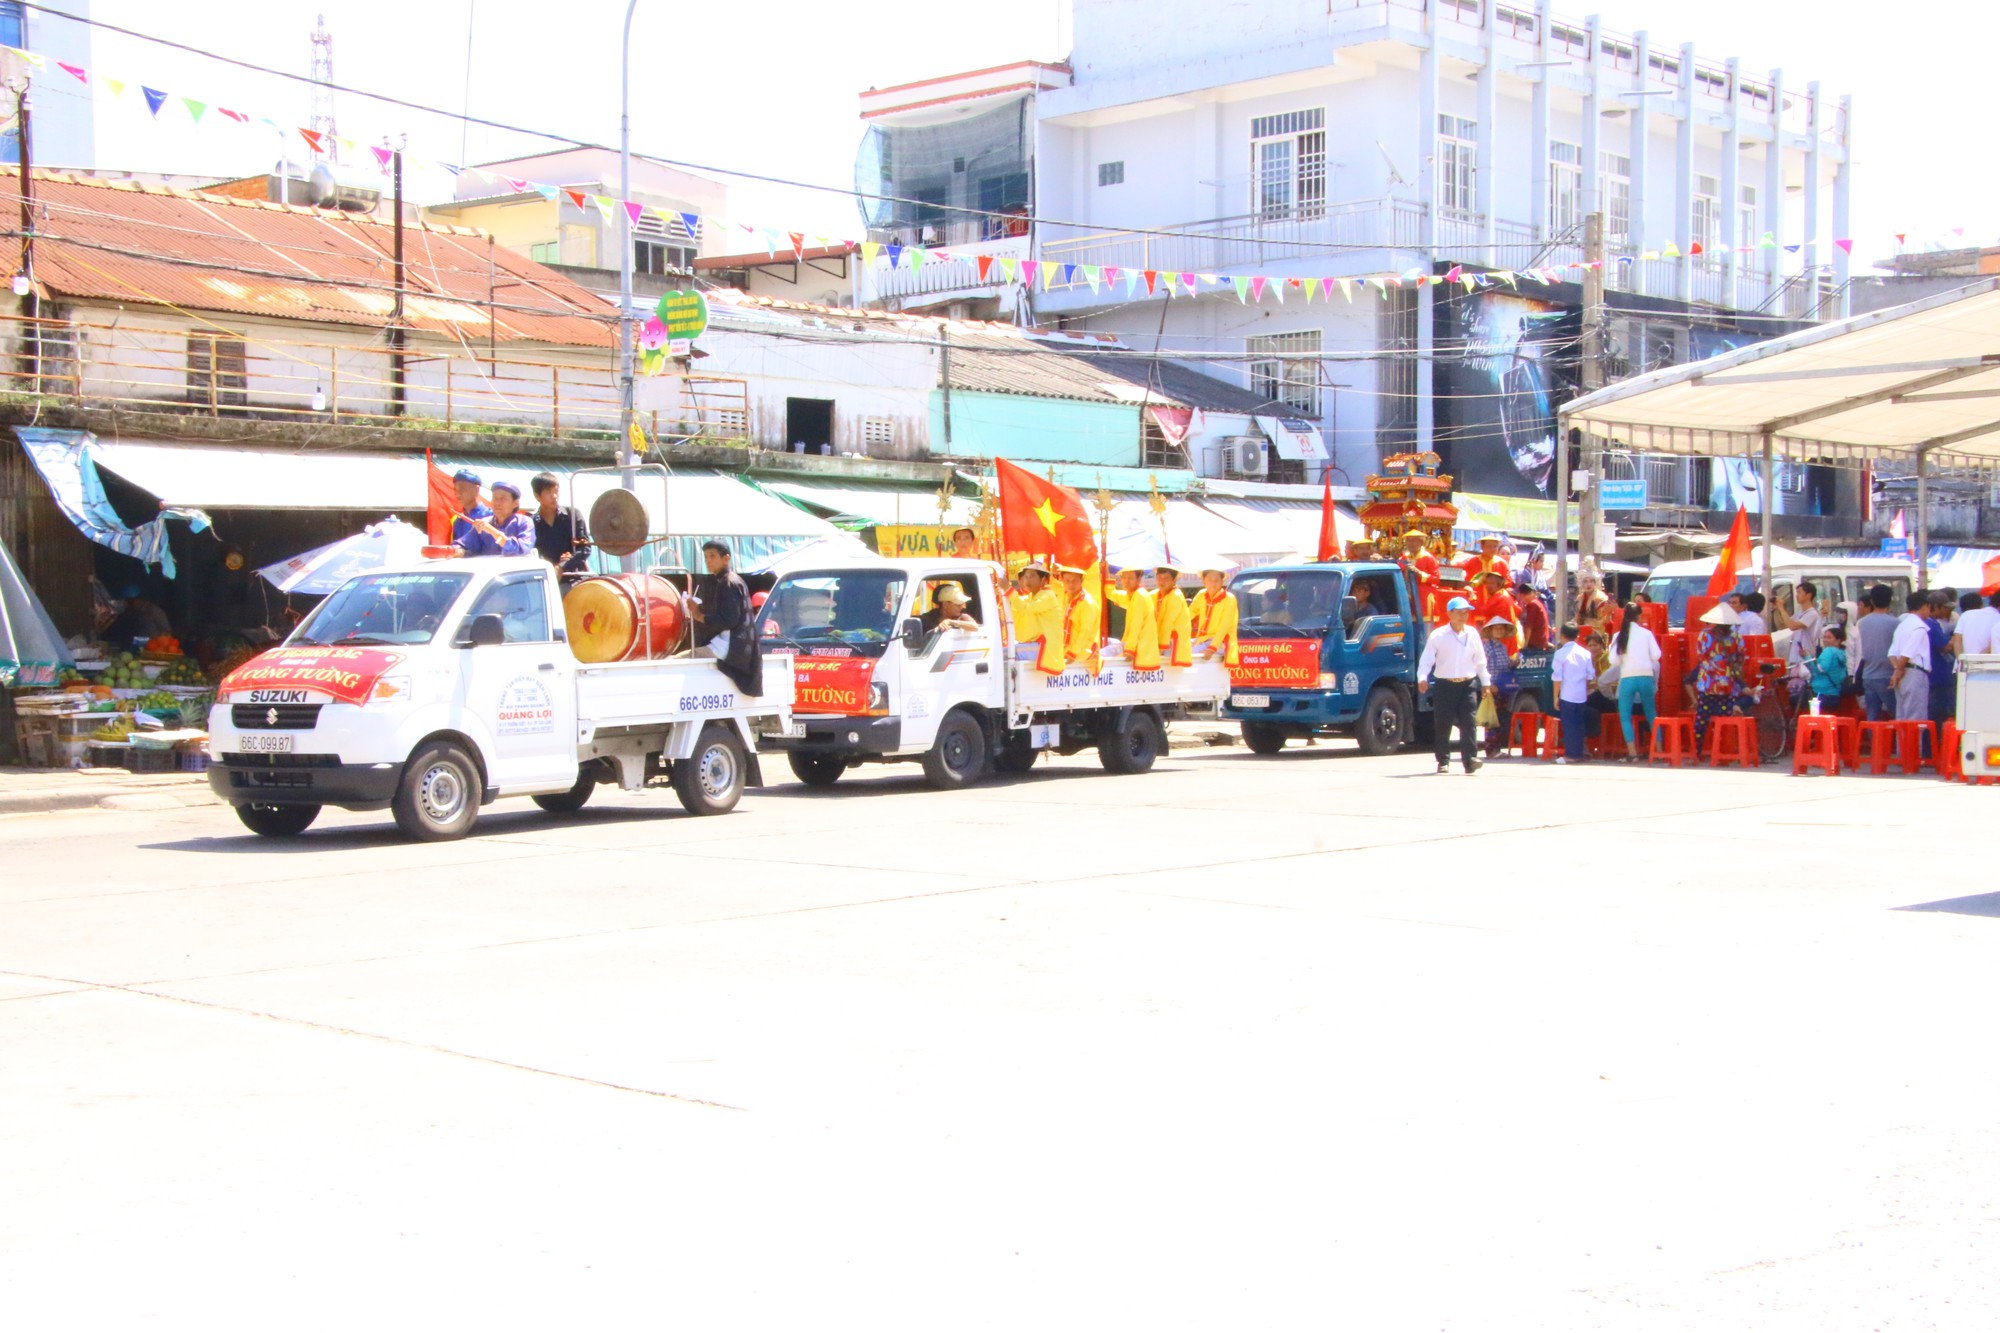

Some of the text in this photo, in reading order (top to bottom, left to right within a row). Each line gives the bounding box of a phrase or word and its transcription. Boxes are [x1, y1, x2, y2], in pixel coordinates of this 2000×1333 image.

[1126, 670, 1165, 684] 66C-045.13
[1264, 664, 1309, 680] TƯỜNG
[250, 690, 308, 703] SUZUKI
[801, 684, 857, 705] TƯỜNG
[679, 694, 734, 711] 66C-099.87
[498, 708, 535, 720] QUẢNG
[241, 736, 290, 751] 66C-099.87
